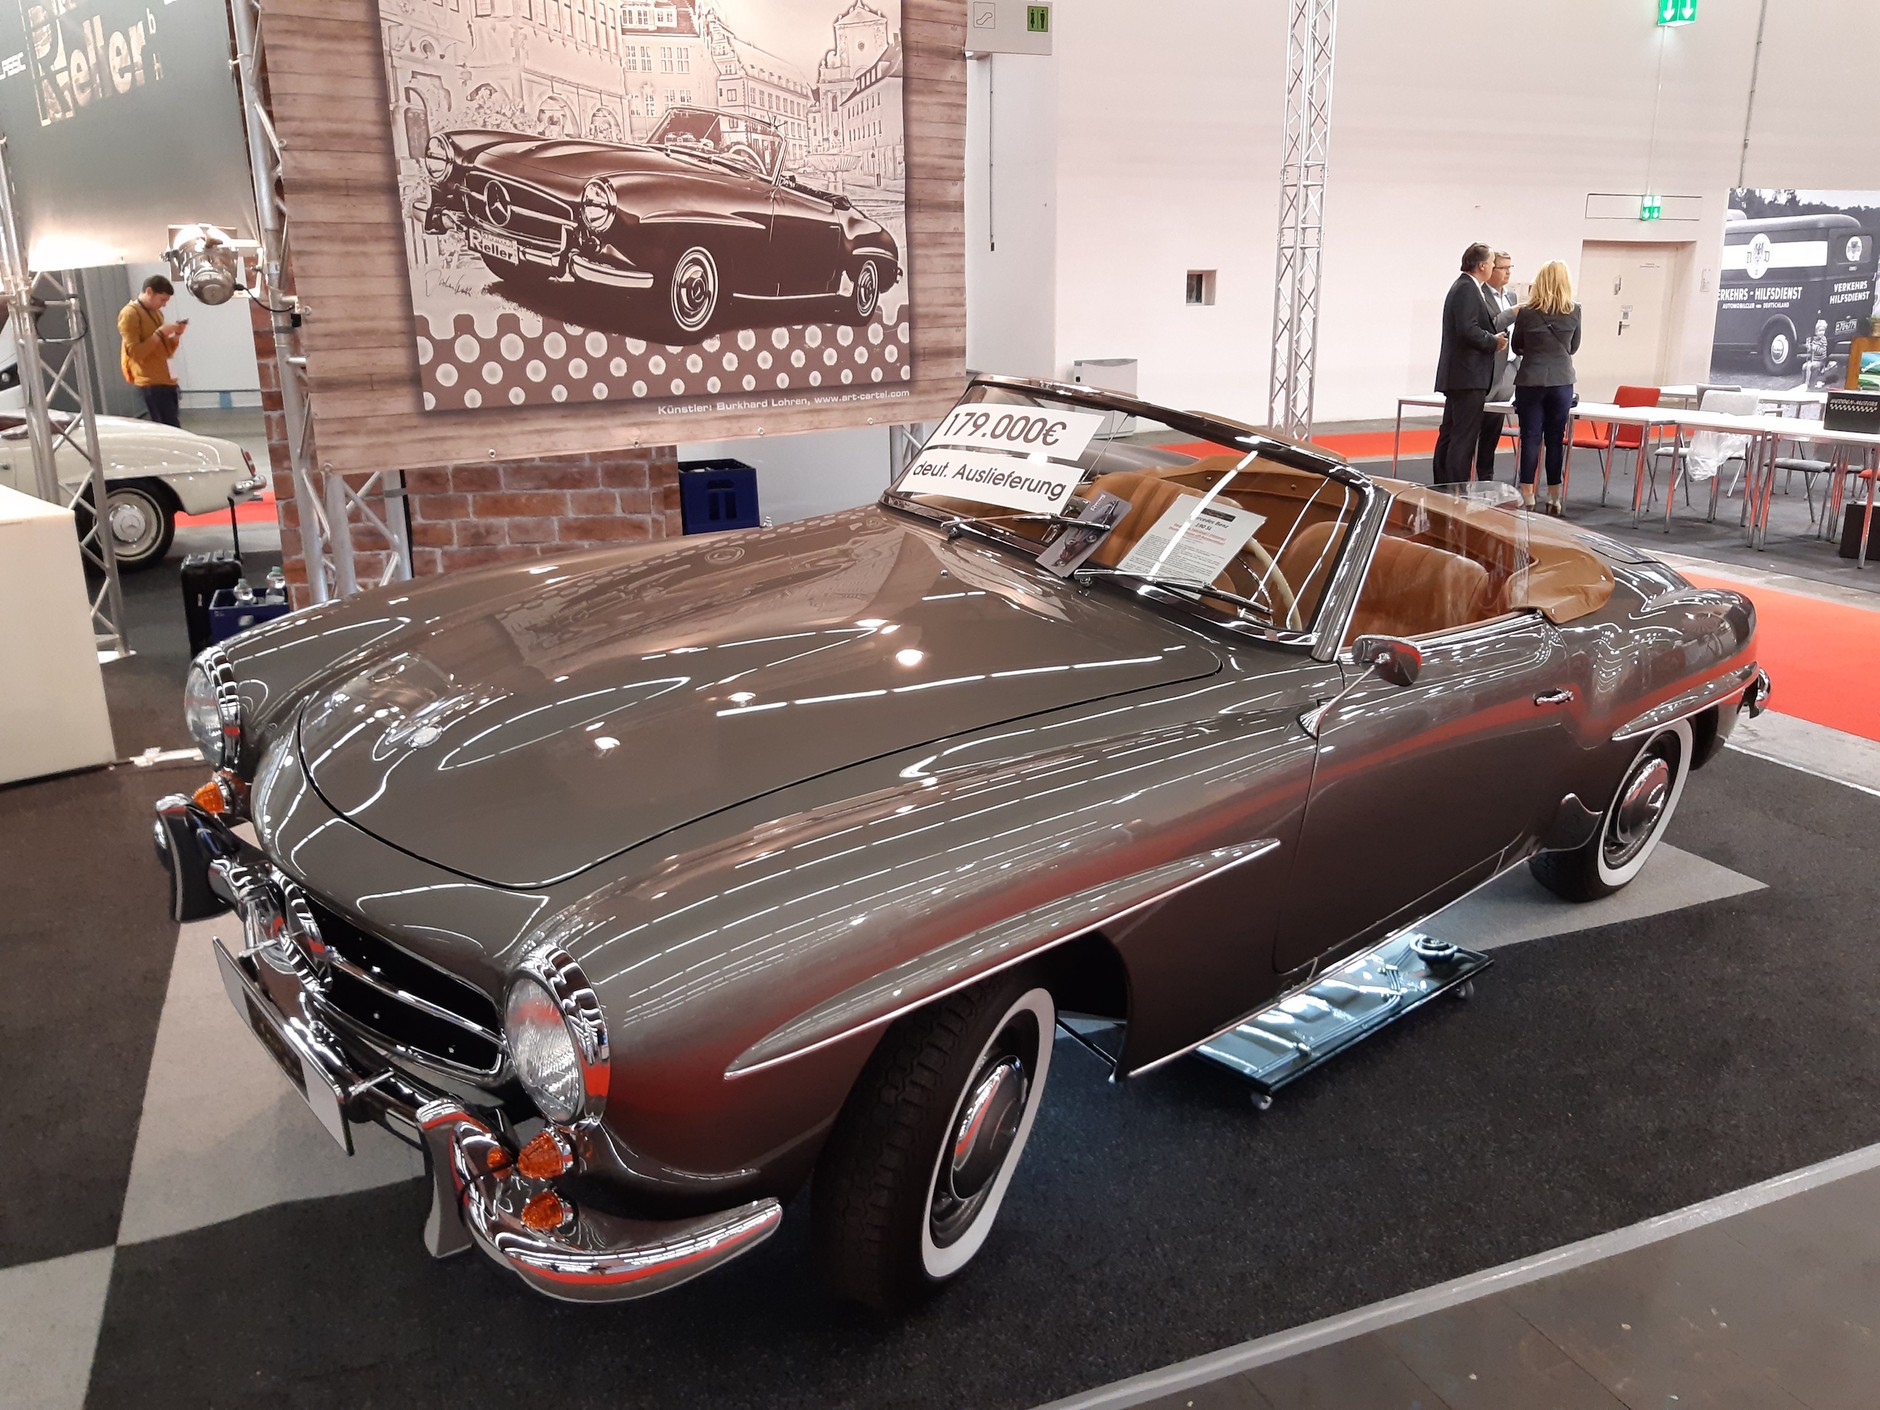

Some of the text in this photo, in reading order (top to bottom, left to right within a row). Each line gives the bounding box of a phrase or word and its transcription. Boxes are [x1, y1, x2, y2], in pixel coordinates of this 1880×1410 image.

[469, 228, 514, 261] Reller
[1717, 288, 1749, 301] ERKEHRS
[1754, 286, 1803, 301] HILFSDIENST
[1833, 280, 1868, 293] VERKEHRS
[1829, 291, 1871, 304] HILFSDIENST
[657, 389, 910, 415] Künstler: Burkhard Lohren, www.art-cartel.com
[943, 412, 1067, 446] 179.000€
[912, 460, 947, 477] deut.
[952, 463, 1067, 502] Auslieferung
[1214, 520, 1230, 529] Benz
